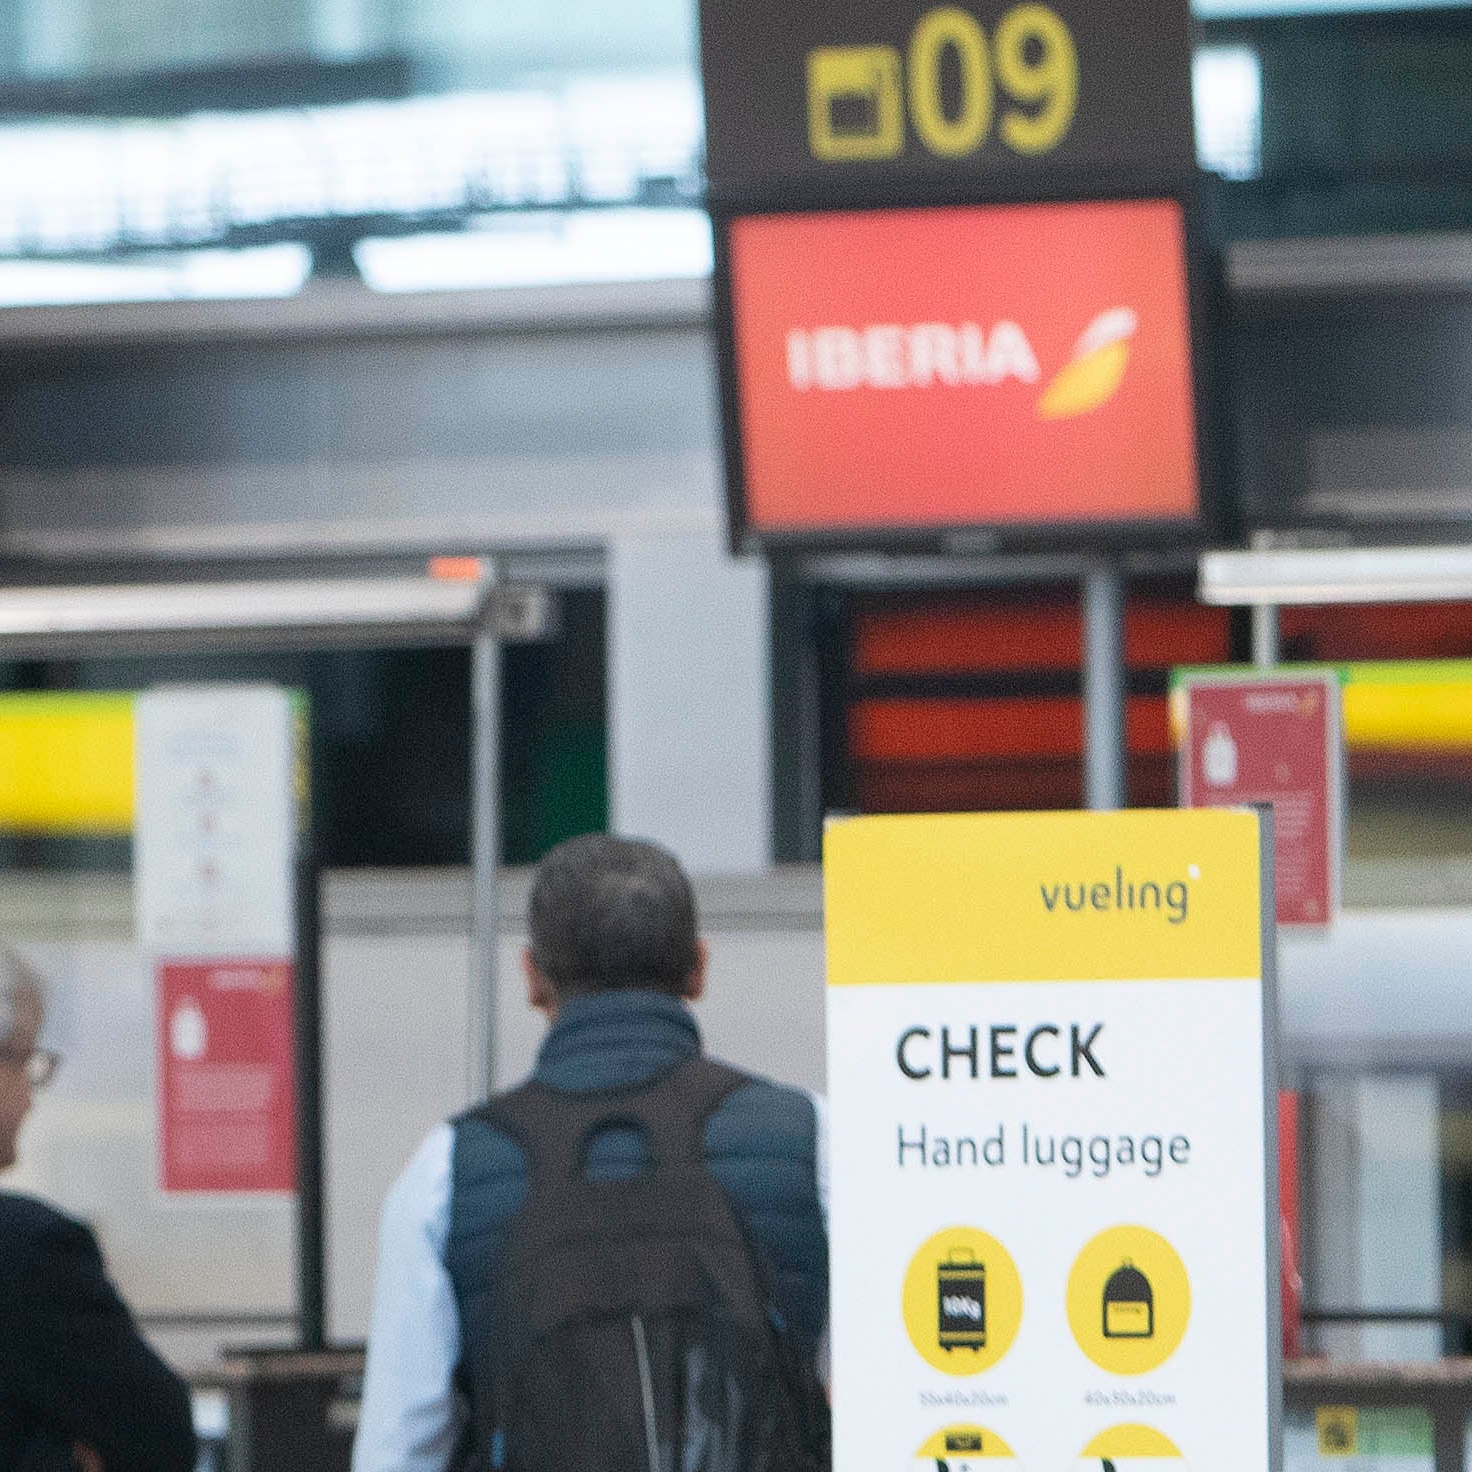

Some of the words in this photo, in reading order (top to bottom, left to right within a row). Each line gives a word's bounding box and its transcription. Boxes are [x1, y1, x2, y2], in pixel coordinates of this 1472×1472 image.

[907, 4, 1079, 156] 09
[785, 320, 1041, 392] IBERIA
[1040, 865, 1189, 923] vueling
[895, 1023, 1106, 1080] CHECK
[896, 1124, 1006, 1168] Hand
[1022, 1124, 1192, 1178] luggage
